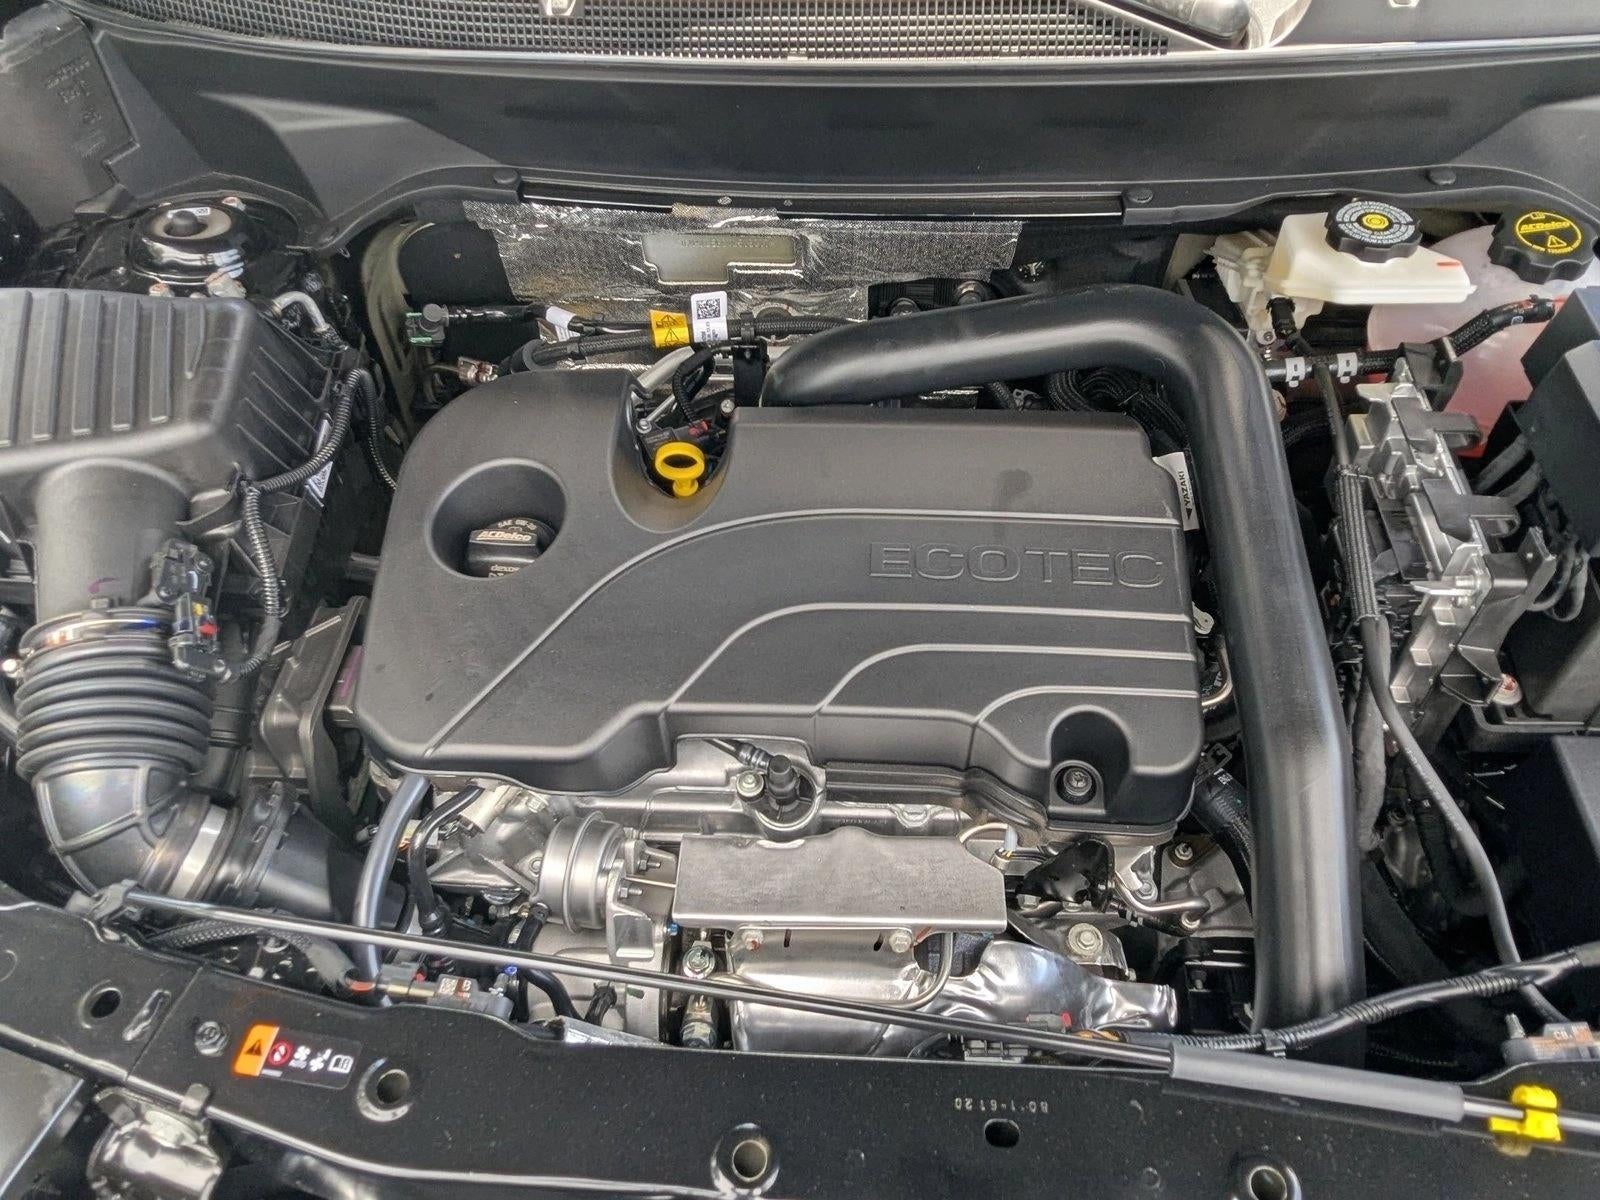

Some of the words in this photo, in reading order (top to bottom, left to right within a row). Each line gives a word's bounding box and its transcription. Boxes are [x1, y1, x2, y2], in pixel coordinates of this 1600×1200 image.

[1178, 470, 1190, 506] YAZAKI
[476, 531, 532, 542] ACDelco
[869, 542, 1164, 589] ECOTEC
